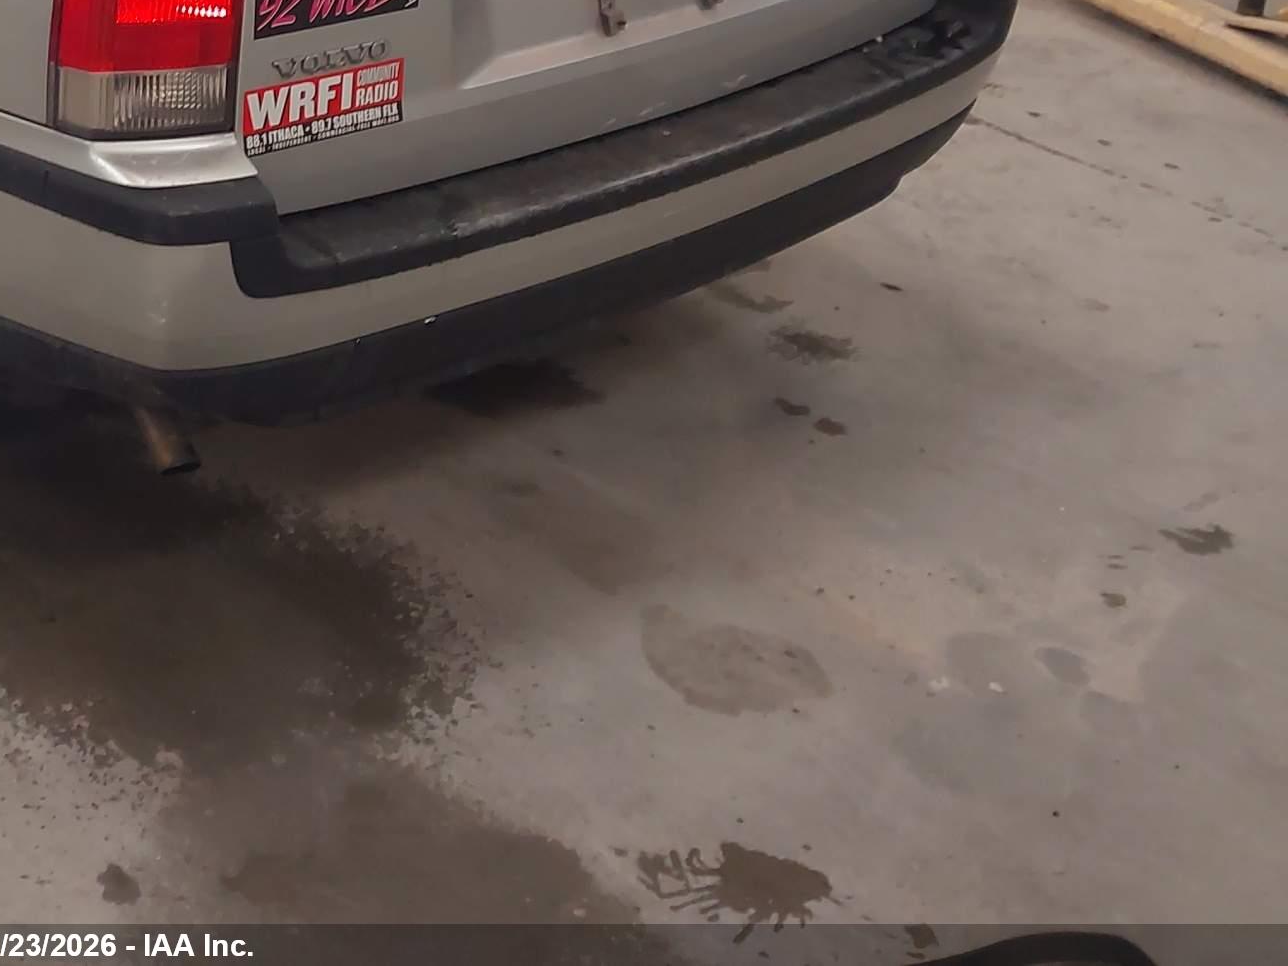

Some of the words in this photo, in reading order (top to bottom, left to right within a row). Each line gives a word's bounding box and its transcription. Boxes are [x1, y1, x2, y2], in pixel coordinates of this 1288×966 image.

[271, 40, 386, 79] VOLVO
[246, 72, 354, 131] WRFI
[355, 80, 399, 107] RADIO
[246, 132, 267, 149] 88.1
[268, 124, 304, 145] ITHACA
[311, 117, 332, 135] 89.7
[333, 106, 382, 129] SOUTHERN
